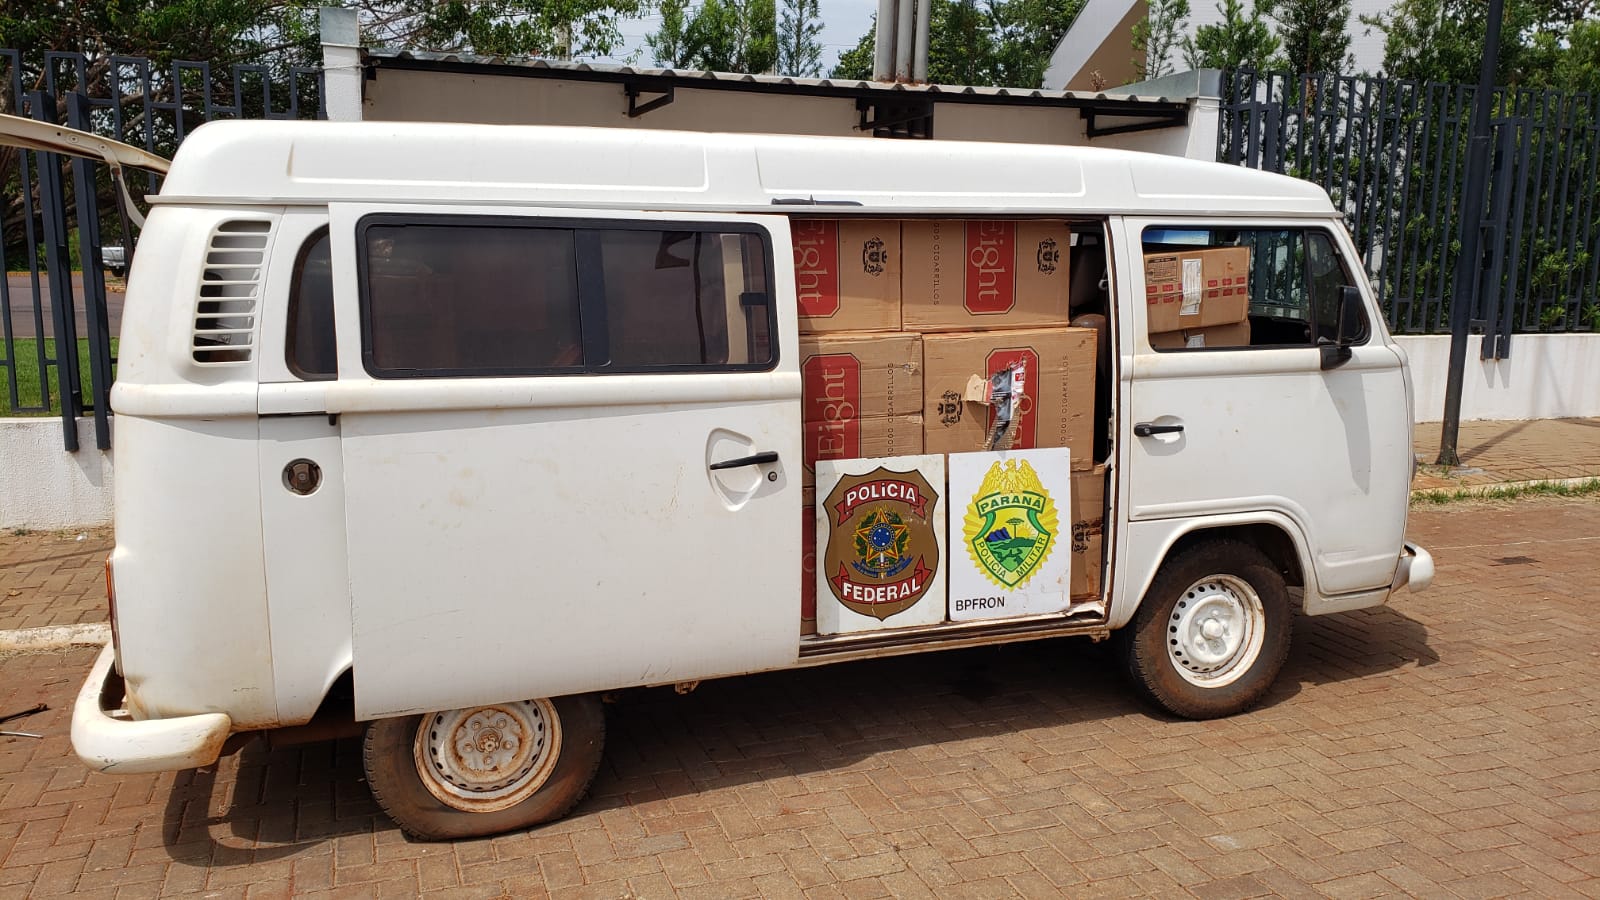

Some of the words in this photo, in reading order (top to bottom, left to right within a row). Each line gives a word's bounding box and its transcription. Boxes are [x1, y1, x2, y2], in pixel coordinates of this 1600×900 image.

[816, 367, 855, 459] Eight
[980, 495, 1041, 512] PARANÁ
[1016, 537, 1046, 577] MILITAR
[842, 577, 921, 602] FEDERAL
[955, 596, 1005, 612] BPFRON
